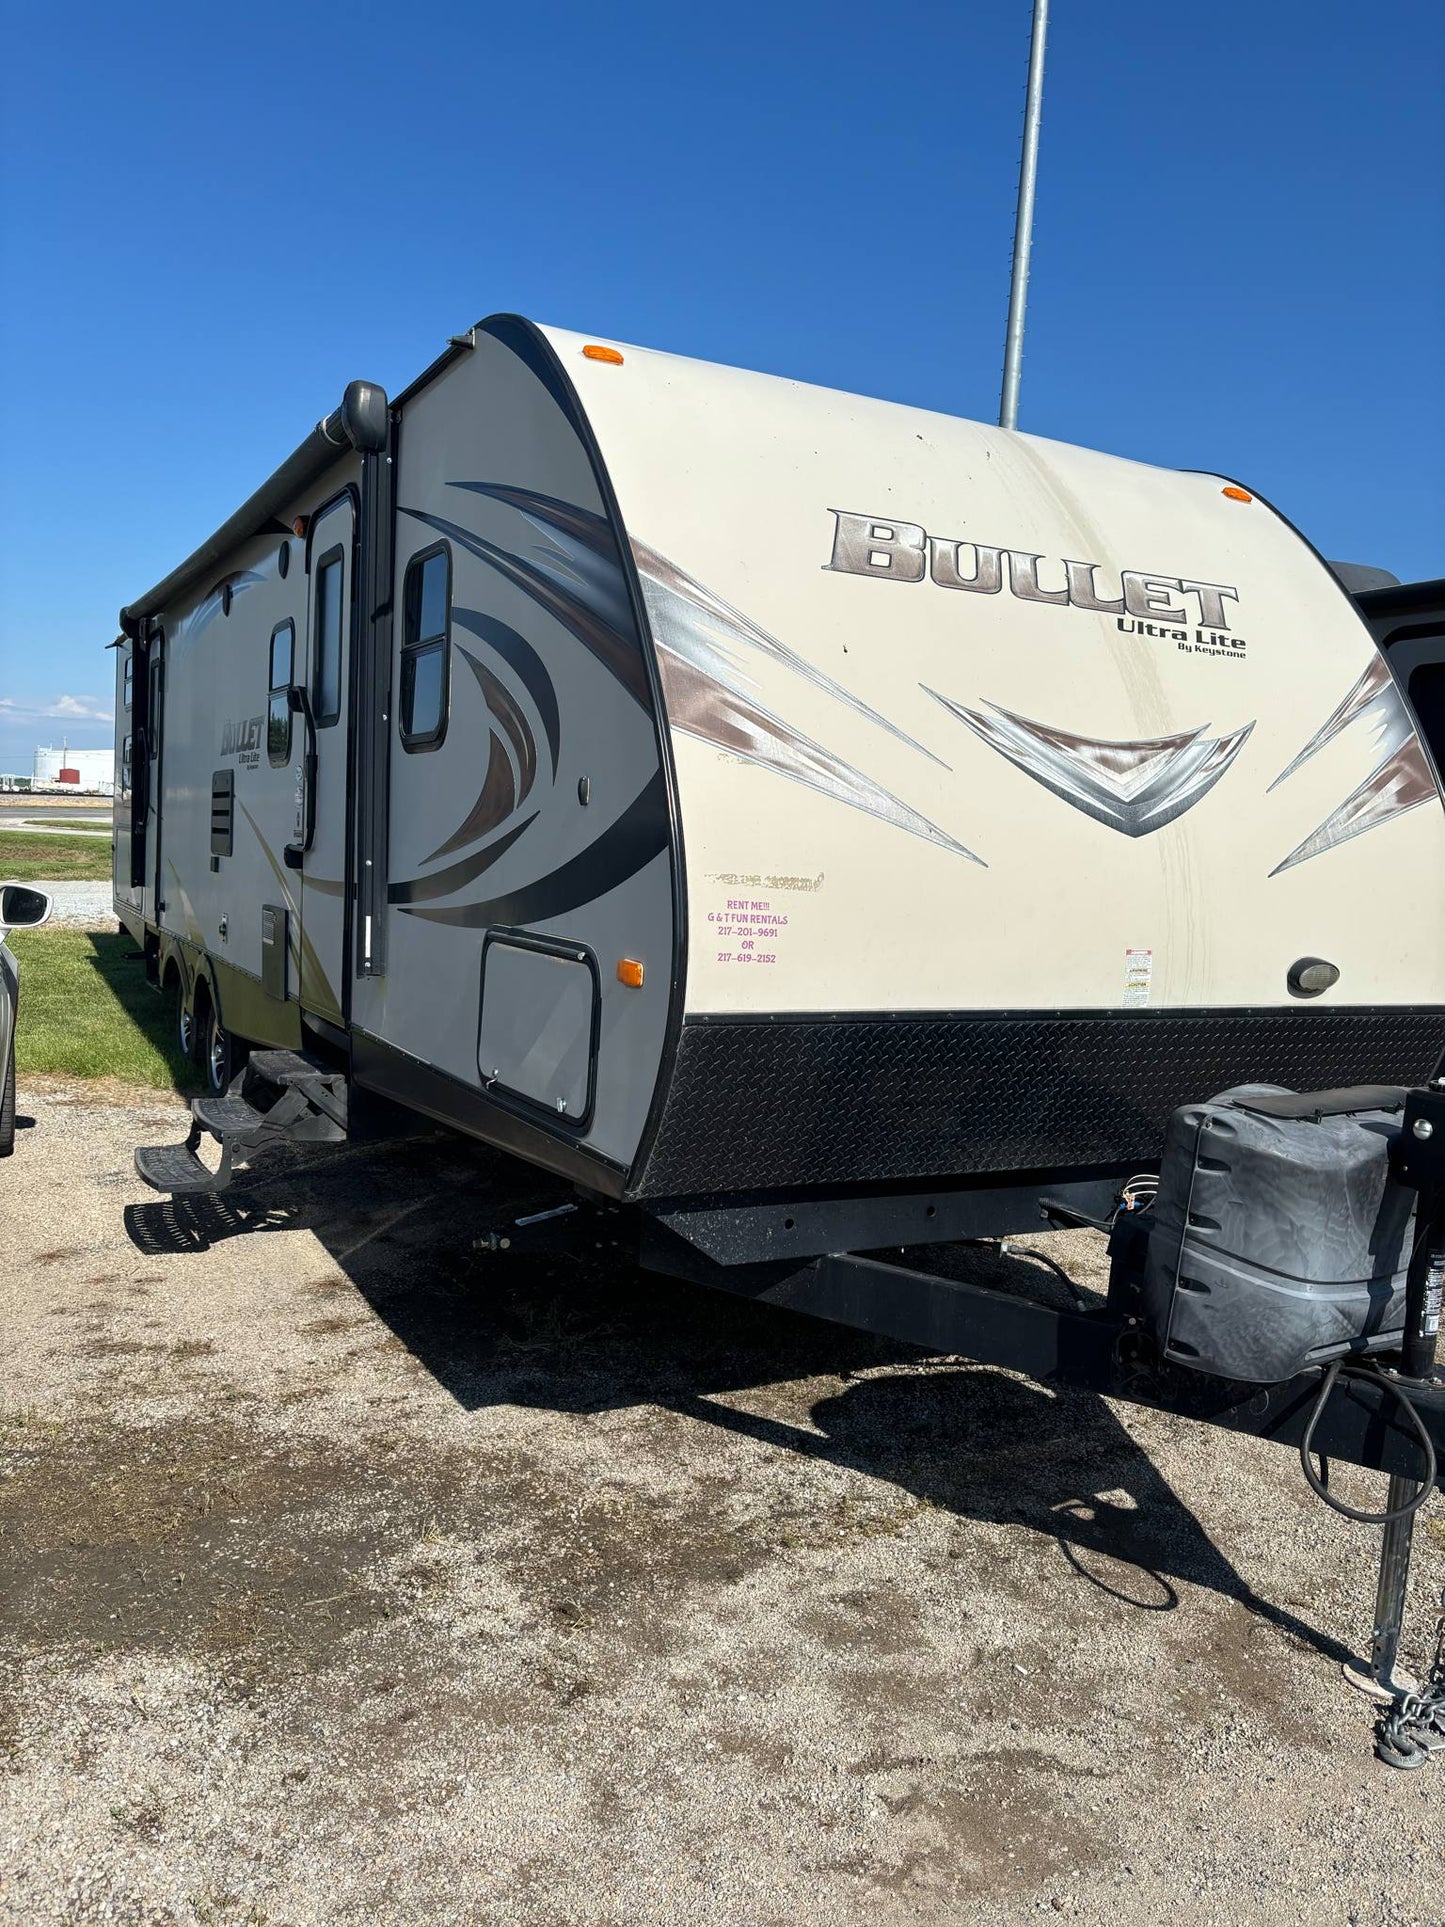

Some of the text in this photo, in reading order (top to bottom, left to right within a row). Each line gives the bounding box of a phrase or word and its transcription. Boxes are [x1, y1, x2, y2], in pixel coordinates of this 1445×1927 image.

[821, 508, 1239, 630] BULLET
[1117, 618, 1246, 650] Ultra Lite
[1178, 642, 1246, 659] By Keystone
[727, 900, 770, 910] RENT ME!!!
[707, 912, 788, 925] G & T FUN RENTALS
[718, 926, 778, 937] 217-201-9691
[741, 940, 754, 950] OR
[717, 952, 776, 963] 217-619-2152
